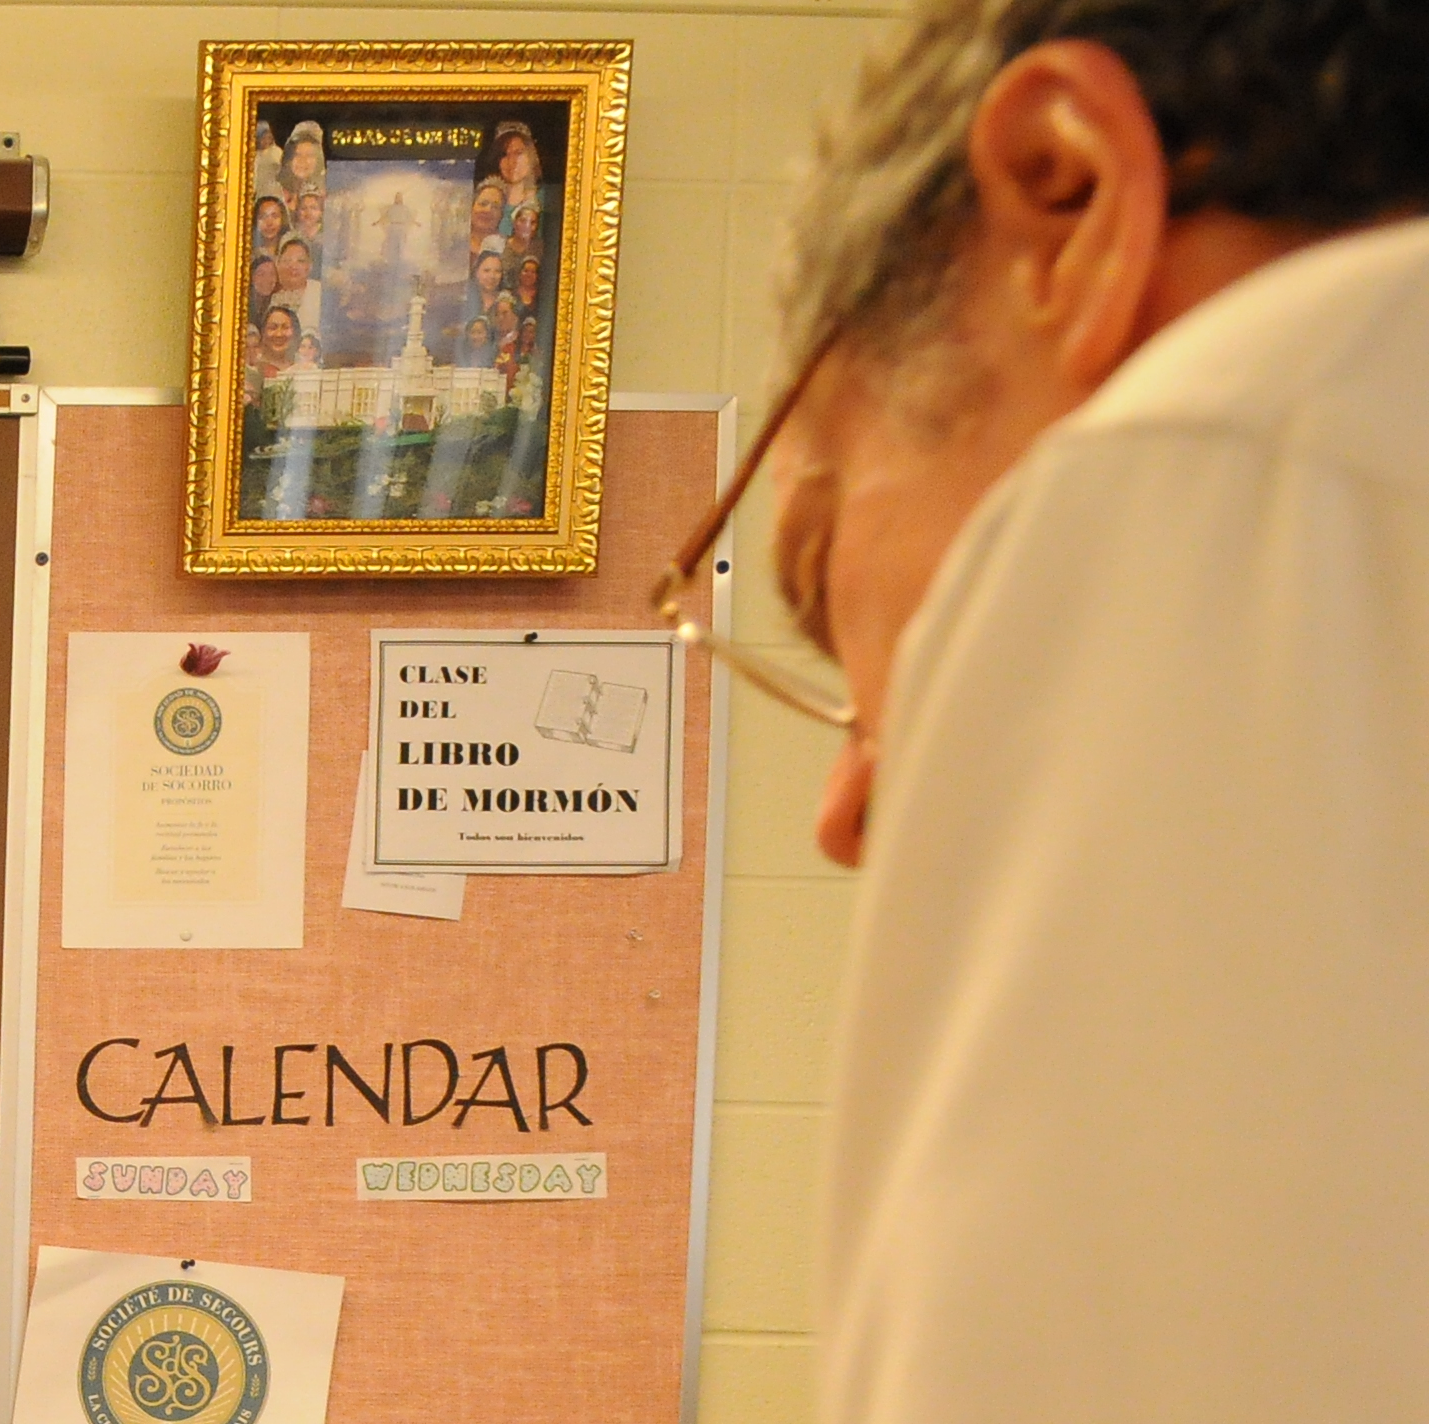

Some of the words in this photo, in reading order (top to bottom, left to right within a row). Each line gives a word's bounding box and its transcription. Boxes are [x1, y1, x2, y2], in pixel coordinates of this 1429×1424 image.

[399, 665, 488, 685] CLASE
[399, 700, 457, 719] DEL
[398, 741, 520, 767] LIBRO
[150, 764, 224, 777] SOCIEDAD
[142, 781, 159, 791] DE
[162, 779, 232, 791] SOCORRO
[397, 787, 448, 812] DE
[461, 783, 641, 814] MORMÓN
[458, 832, 491, 842] Todos
[517, 832, 585, 842] bienvenidos
[76, 1037, 594, 1133] CALENDAR
[83, 1161, 248, 1200] SUNDAY
[362, 1161, 602, 1194] WEDNESDAY
[167, 1287, 195, 1303] DE
[199, 1292, 262, 1366] SECOURS
[88, 1394, 99, 1412] LA
